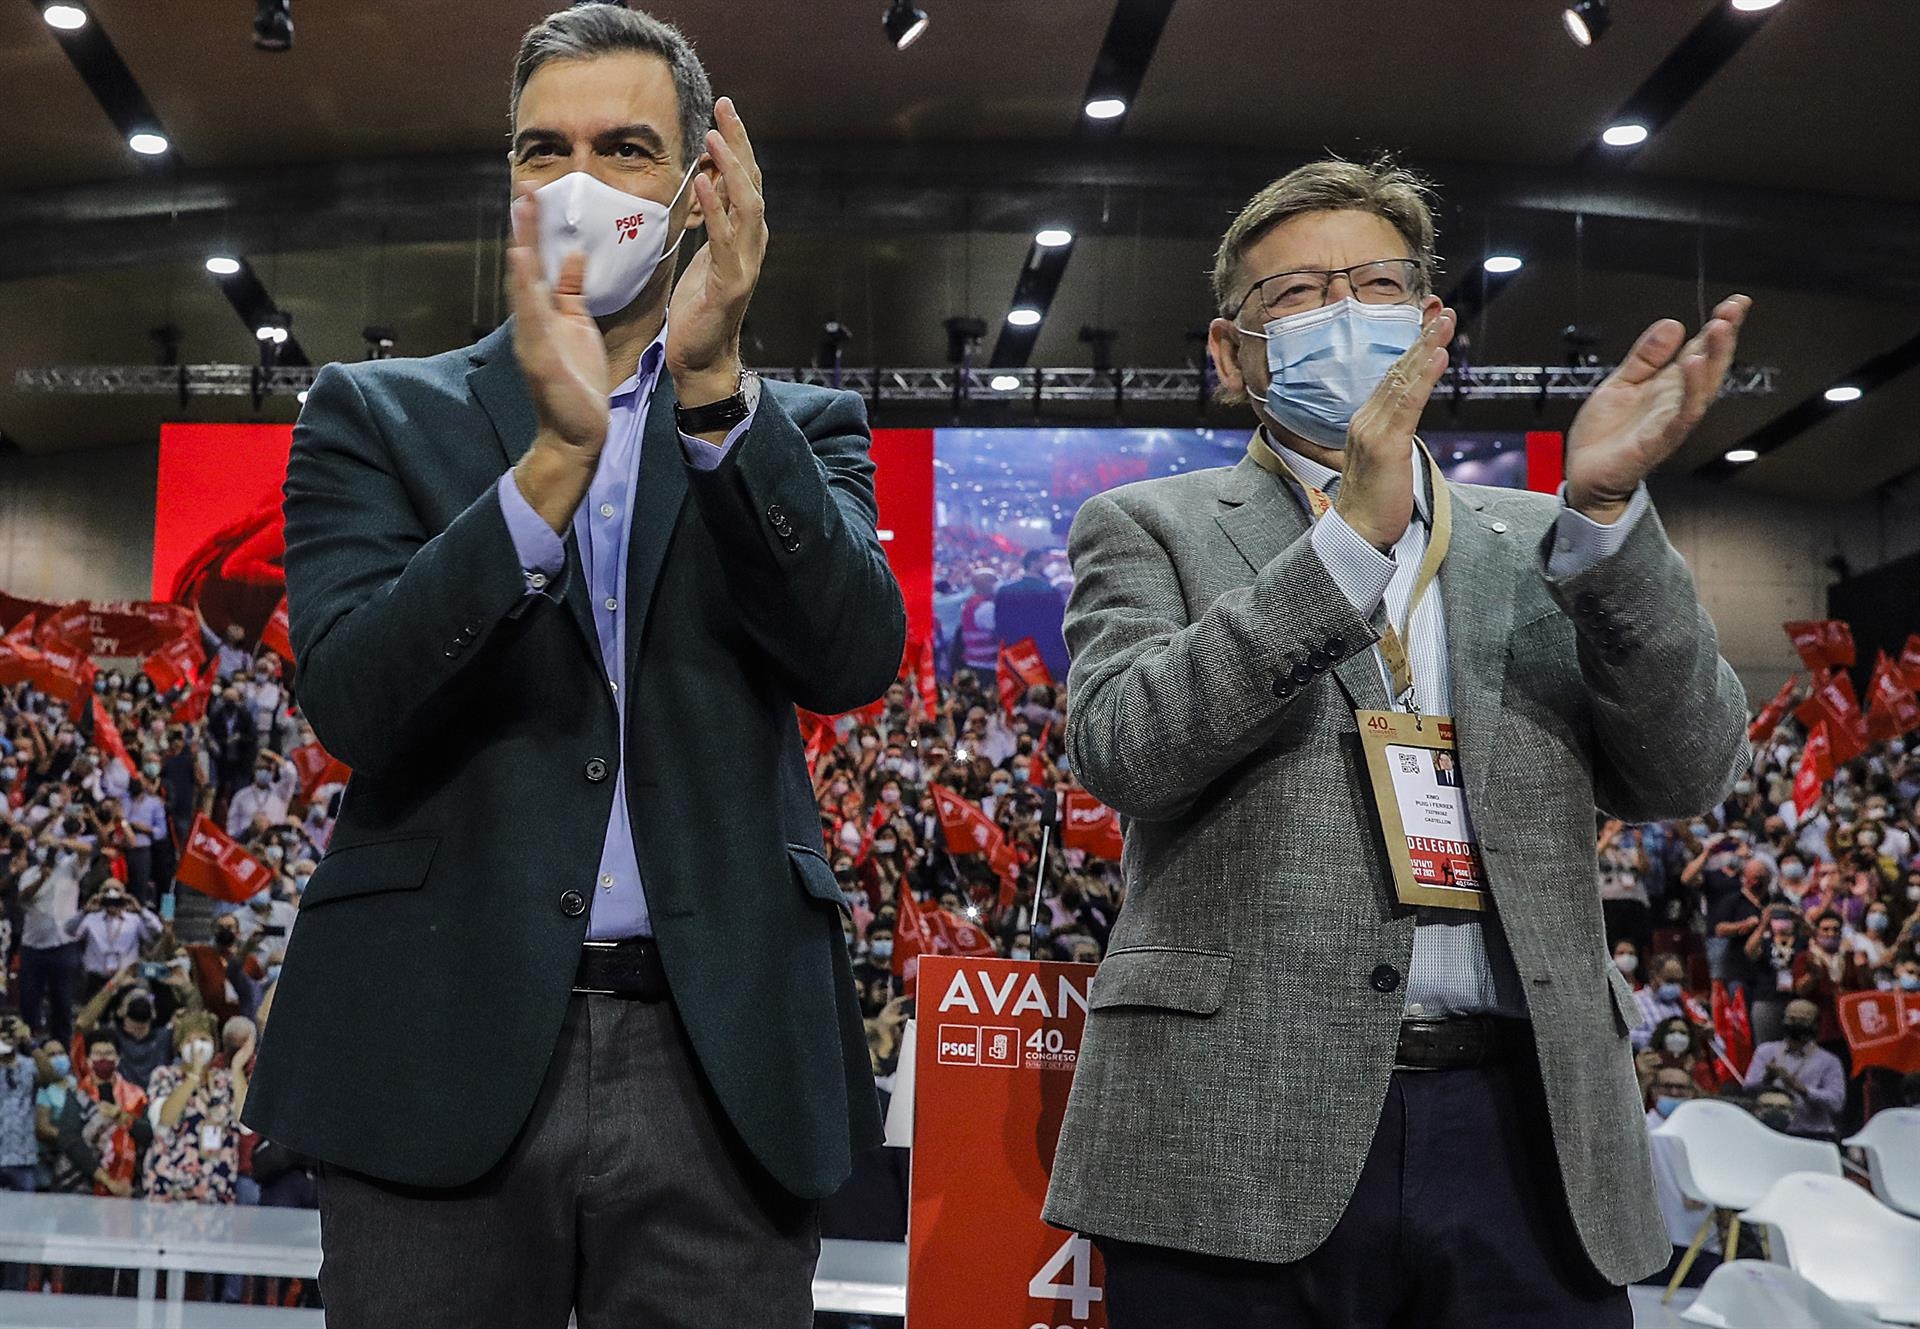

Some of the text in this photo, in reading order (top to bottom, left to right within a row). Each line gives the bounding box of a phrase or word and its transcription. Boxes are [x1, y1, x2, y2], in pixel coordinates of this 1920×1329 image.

[616, 213, 645, 231] PSOE
[941, 1042, 976, 1057] PSOE
[1025, 1051, 1076, 1062] CONGRESO
